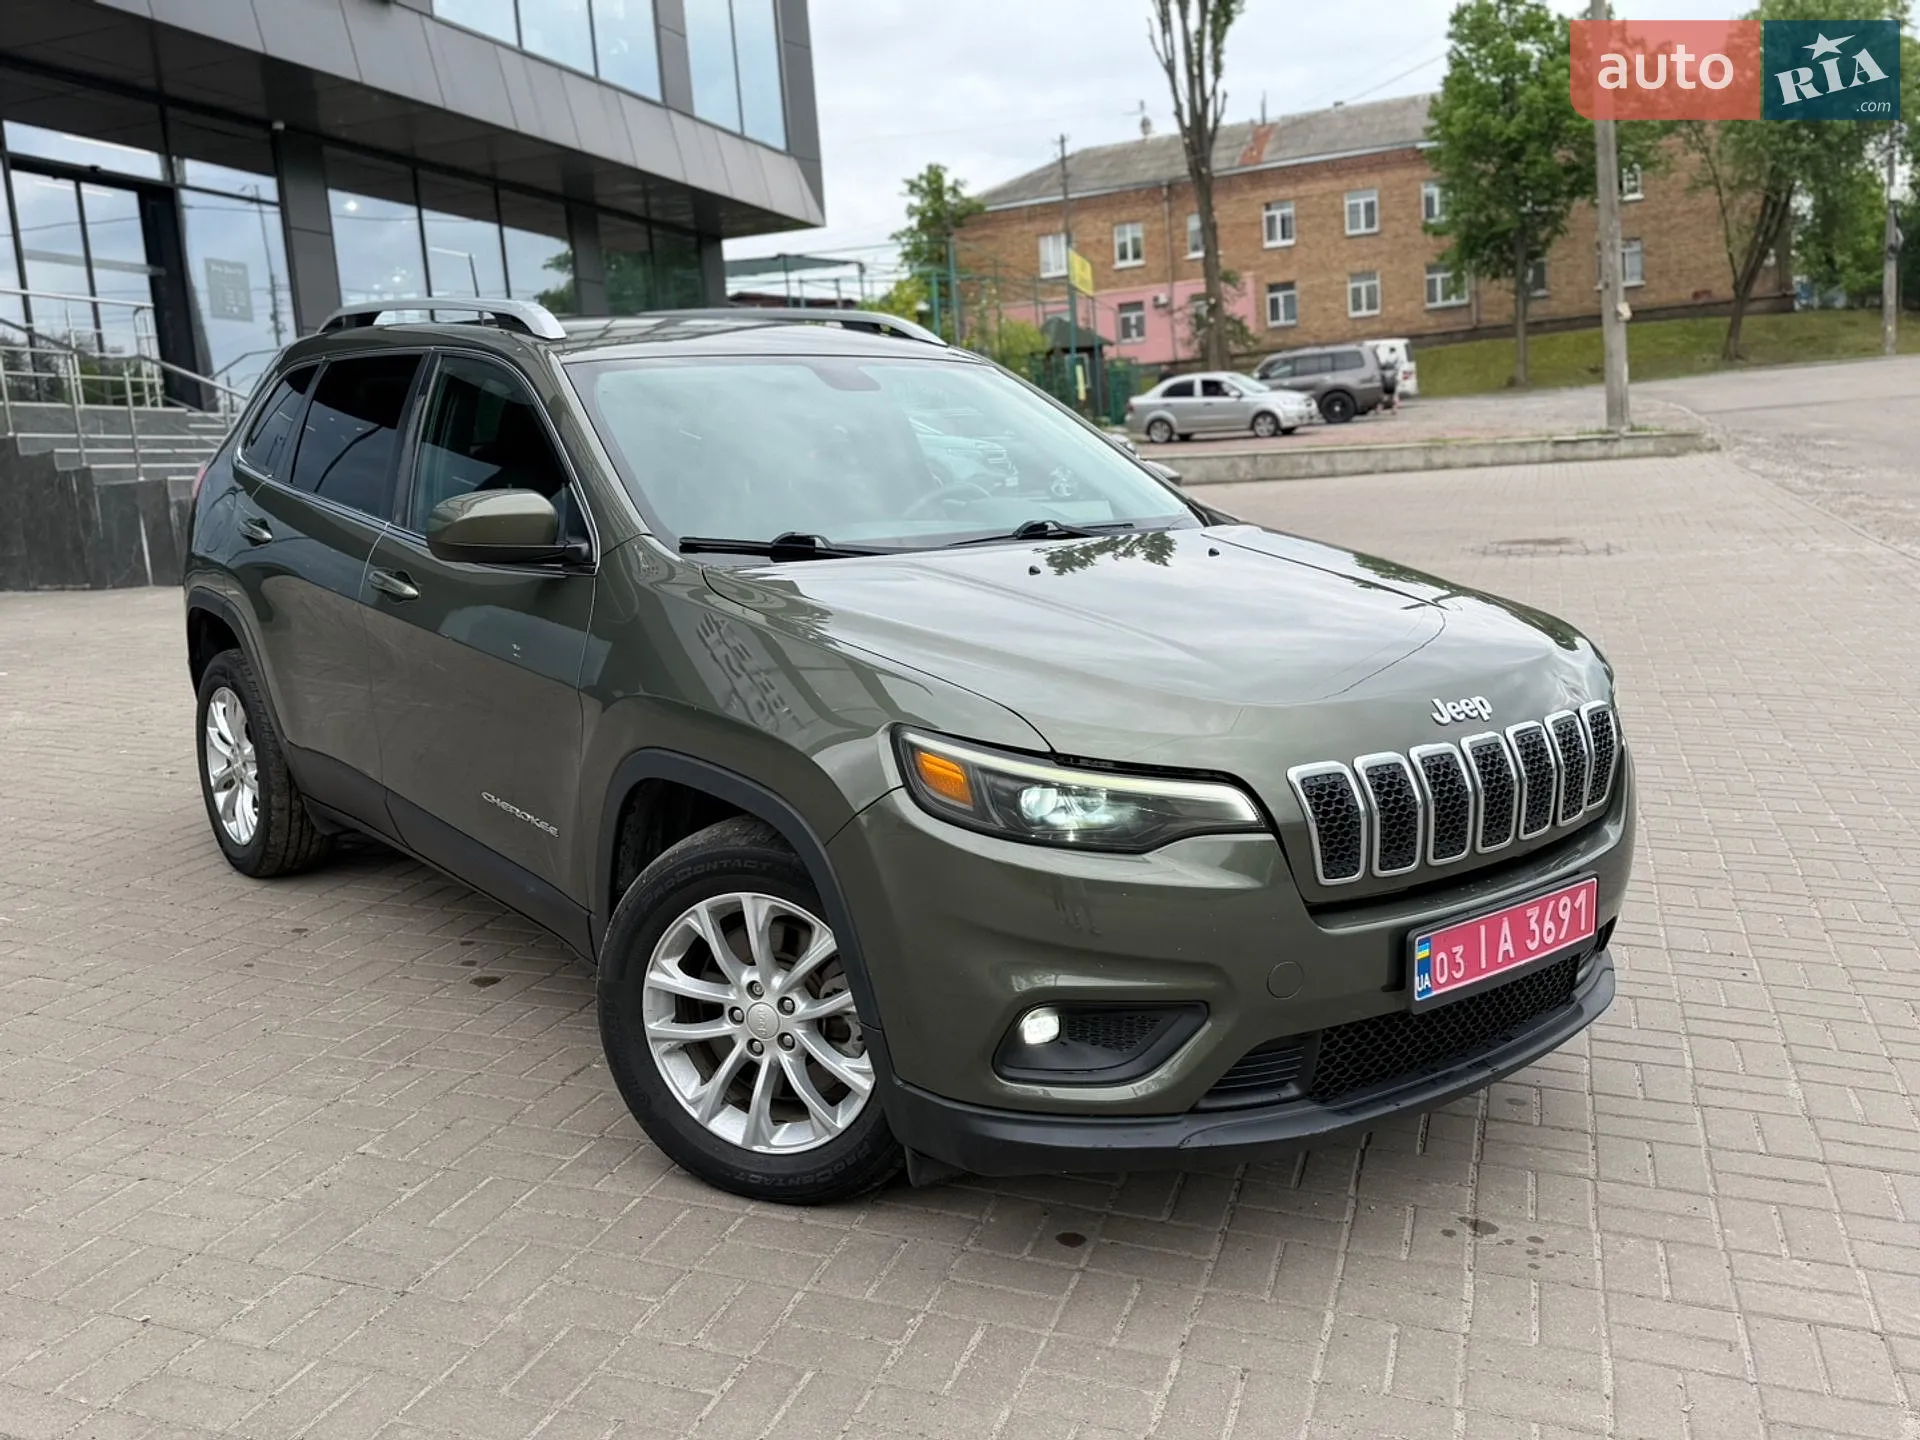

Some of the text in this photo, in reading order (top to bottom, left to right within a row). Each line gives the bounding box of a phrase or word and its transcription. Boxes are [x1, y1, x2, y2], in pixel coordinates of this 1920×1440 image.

[1431, 696, 1493, 724] Jeep
[481, 791, 559, 837] CHEROKEE
[1435, 888, 1588, 984] 03 IA 3691
[1416, 974, 1432, 992] UA
